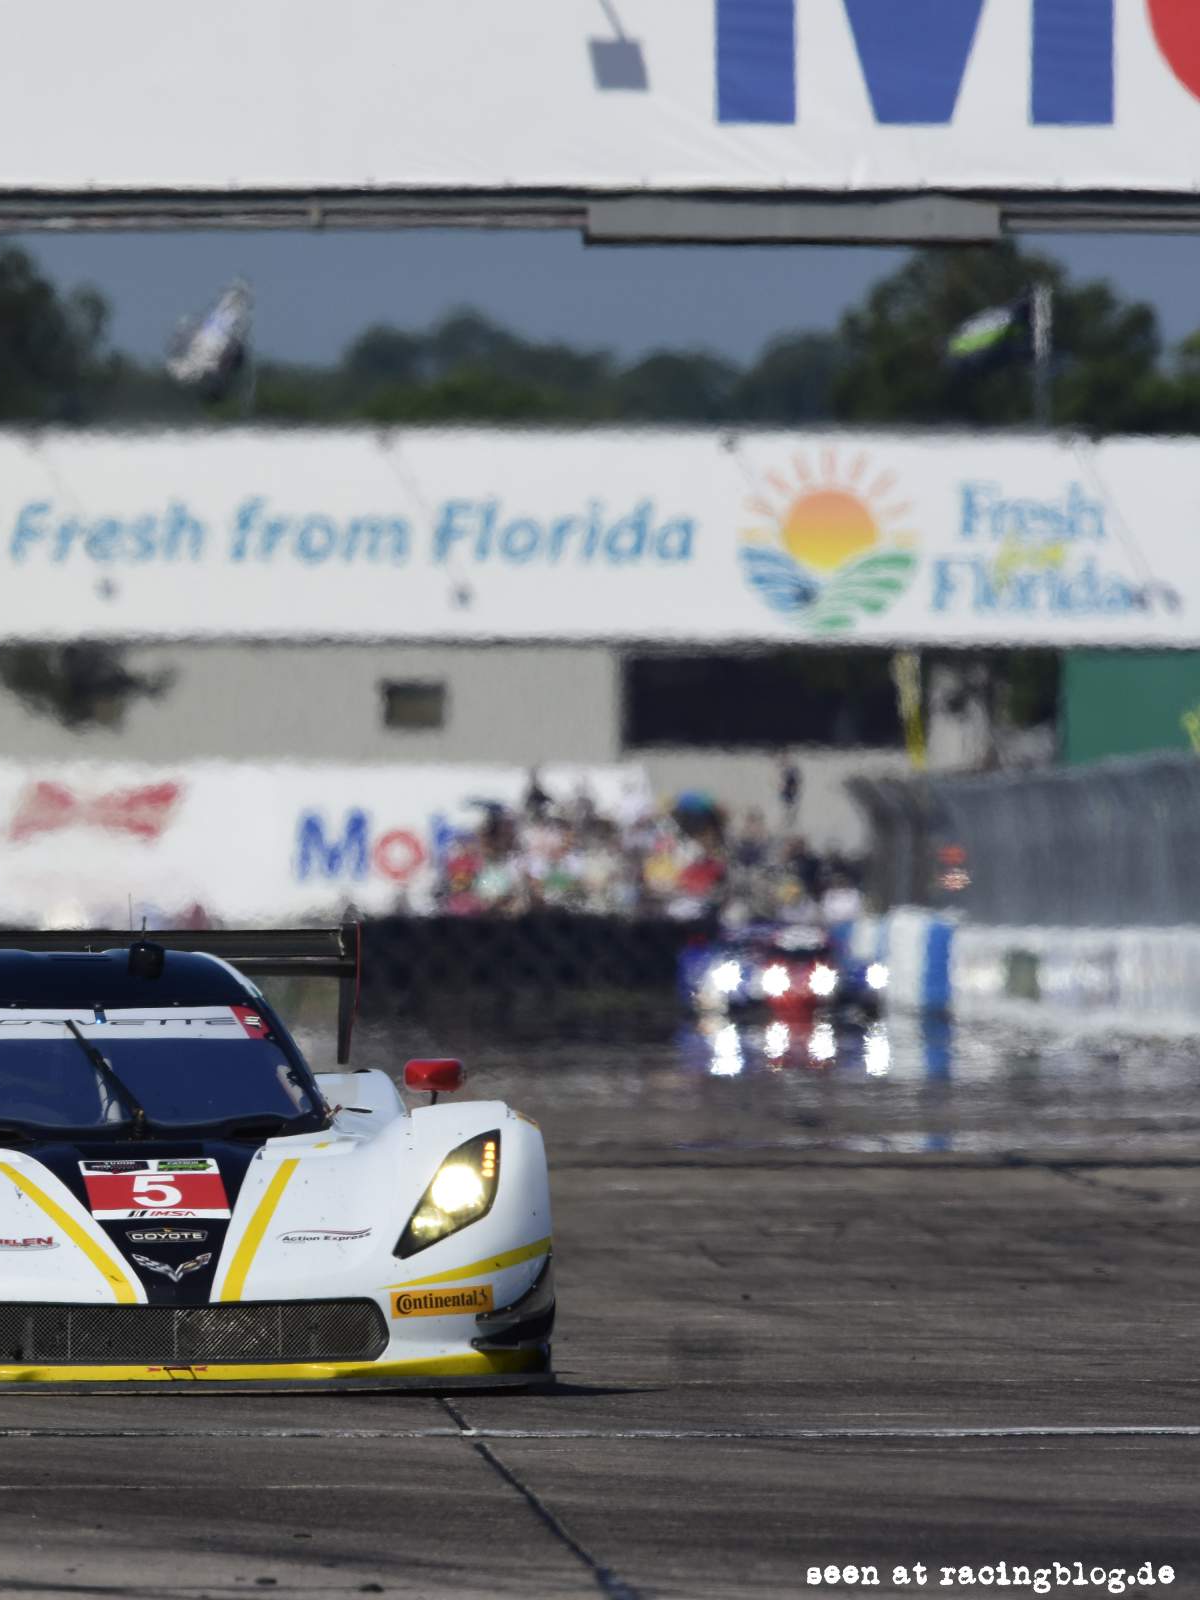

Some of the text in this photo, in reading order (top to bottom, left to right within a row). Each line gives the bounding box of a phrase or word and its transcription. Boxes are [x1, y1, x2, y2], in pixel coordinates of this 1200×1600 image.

[8, 498, 208, 564] Fresh
[226, 496, 412, 564] from
[432, 496, 699, 565] Florida
[132, 1174, 183, 1208] 5
[131, 1231, 204, 1241] COYOTE
[282, 1235, 320, 1243] Action
[396, 1289, 478, 1315] Continental
